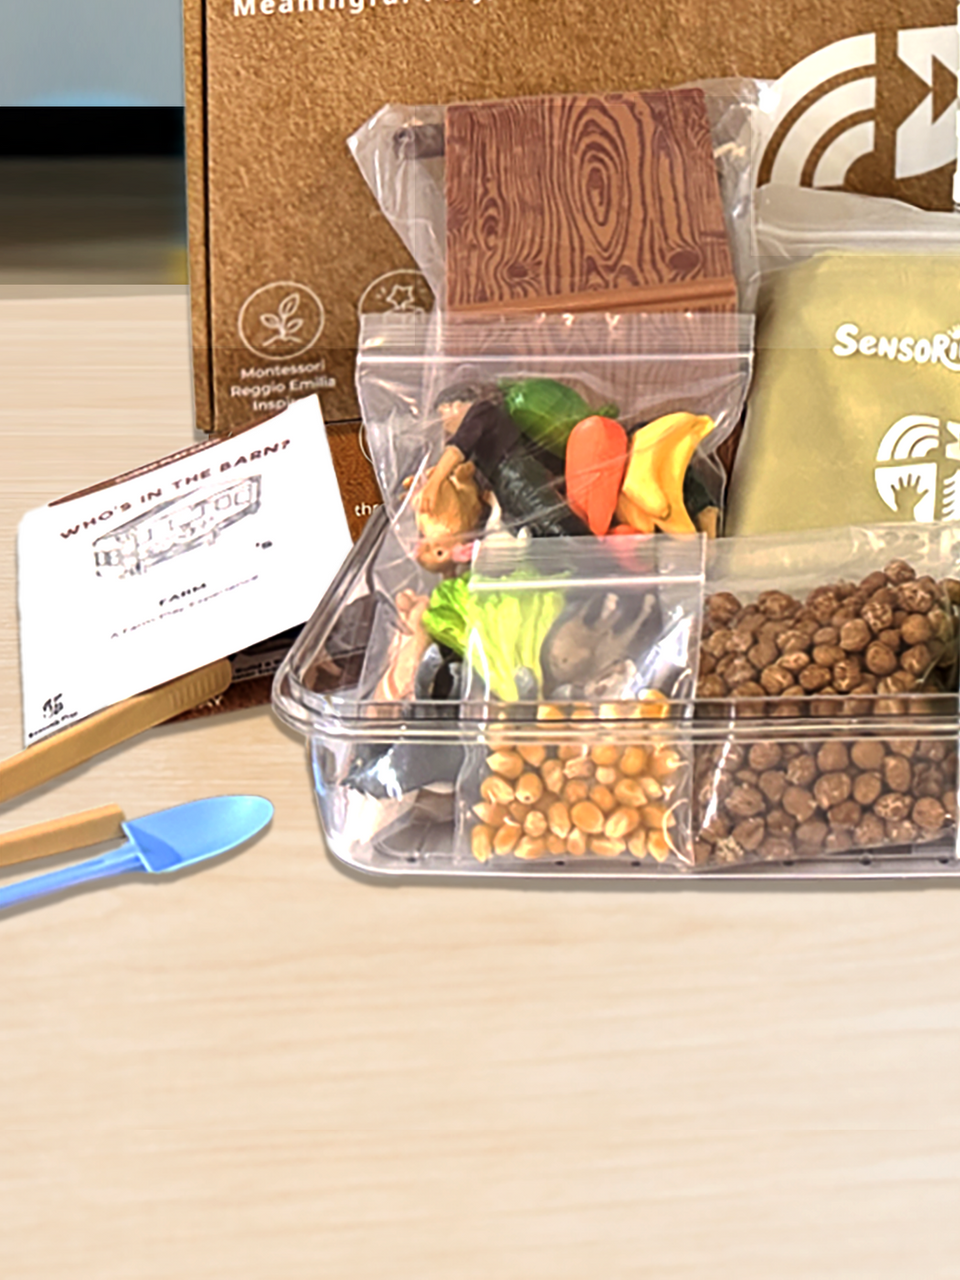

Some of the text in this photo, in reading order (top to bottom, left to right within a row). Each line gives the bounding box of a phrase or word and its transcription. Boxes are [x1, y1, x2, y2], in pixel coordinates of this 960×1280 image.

[241, 359, 326, 380] Montessori
[230, 376, 336, 398] Reggio Emilia
[60, 502, 131, 539] WHO'S
[140, 489, 162, 503] IN
[172, 468, 211, 489] THE
[219, 439, 290, 472] BARN?
